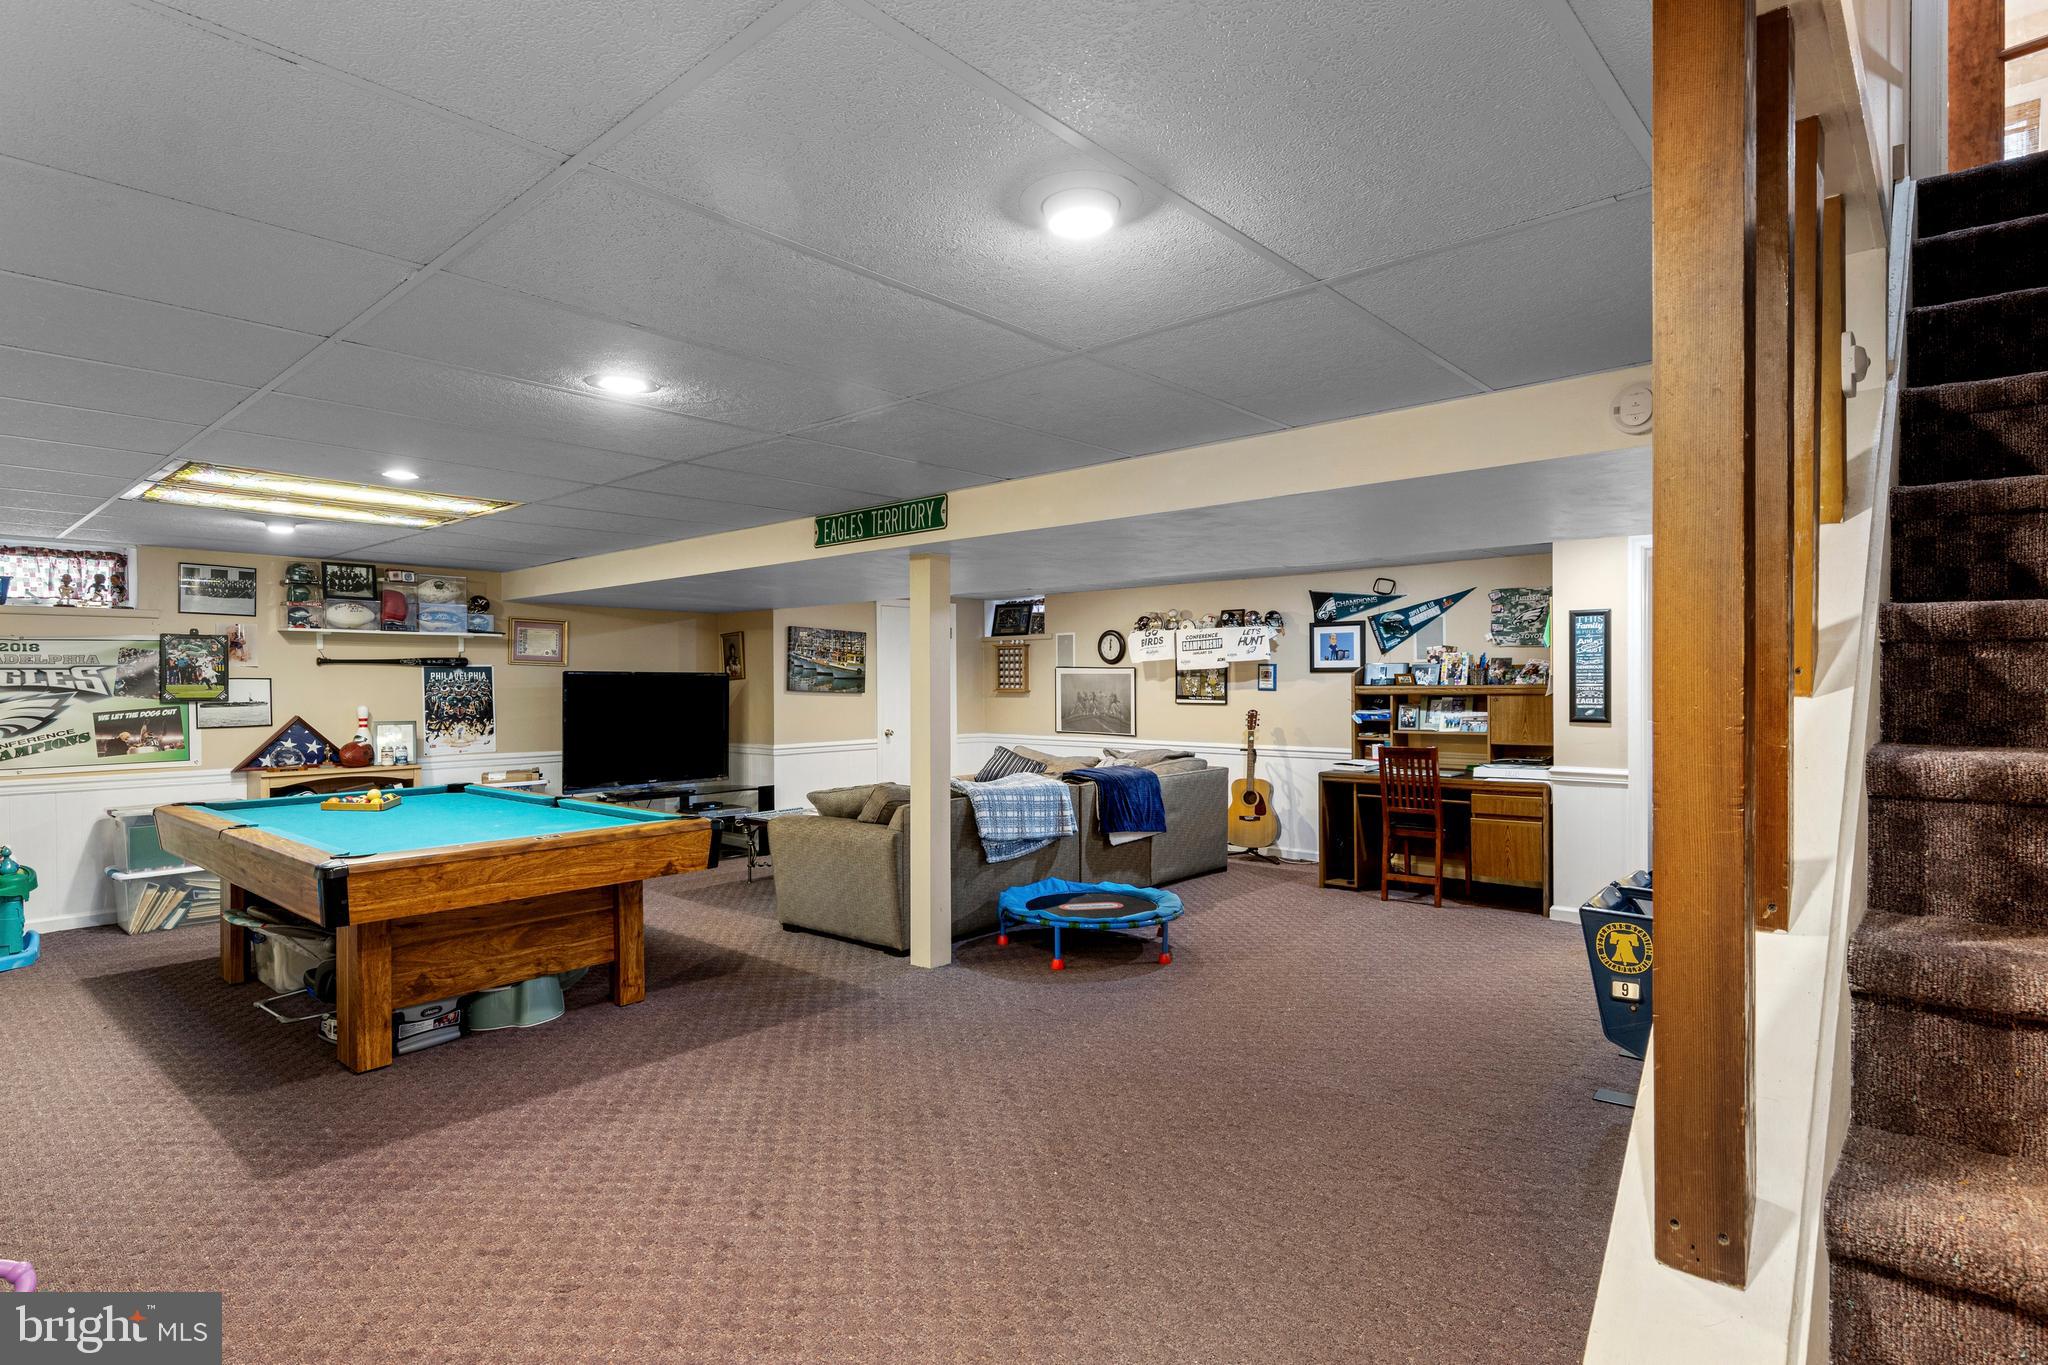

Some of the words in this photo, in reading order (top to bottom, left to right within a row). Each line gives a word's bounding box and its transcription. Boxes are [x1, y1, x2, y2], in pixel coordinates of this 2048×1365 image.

[823, 513, 864, 543] EAGLES
[871, 500, 935, 536] TERRITORY
[1335, 596, 1378, 608] CHAMPIONS
[1144, 629, 1159, 637] GO
[1185, 632, 1219, 640] CONFERENCE
[1141, 636, 1164, 648] BIRDS
[1237, 635, 1265, 646] HUNT
[0, 643, 40, 652] 2018
[430, 671, 487, 680] PHILADELPHIA
[97, 713, 110, 722] WE
[111, 712, 125, 720] LET
[125, 711, 139, 719] THE
[139, 709, 161, 718] DOGS
[162, 708, 178, 716] OUT
[1621, 982, 1629, 997] 9
